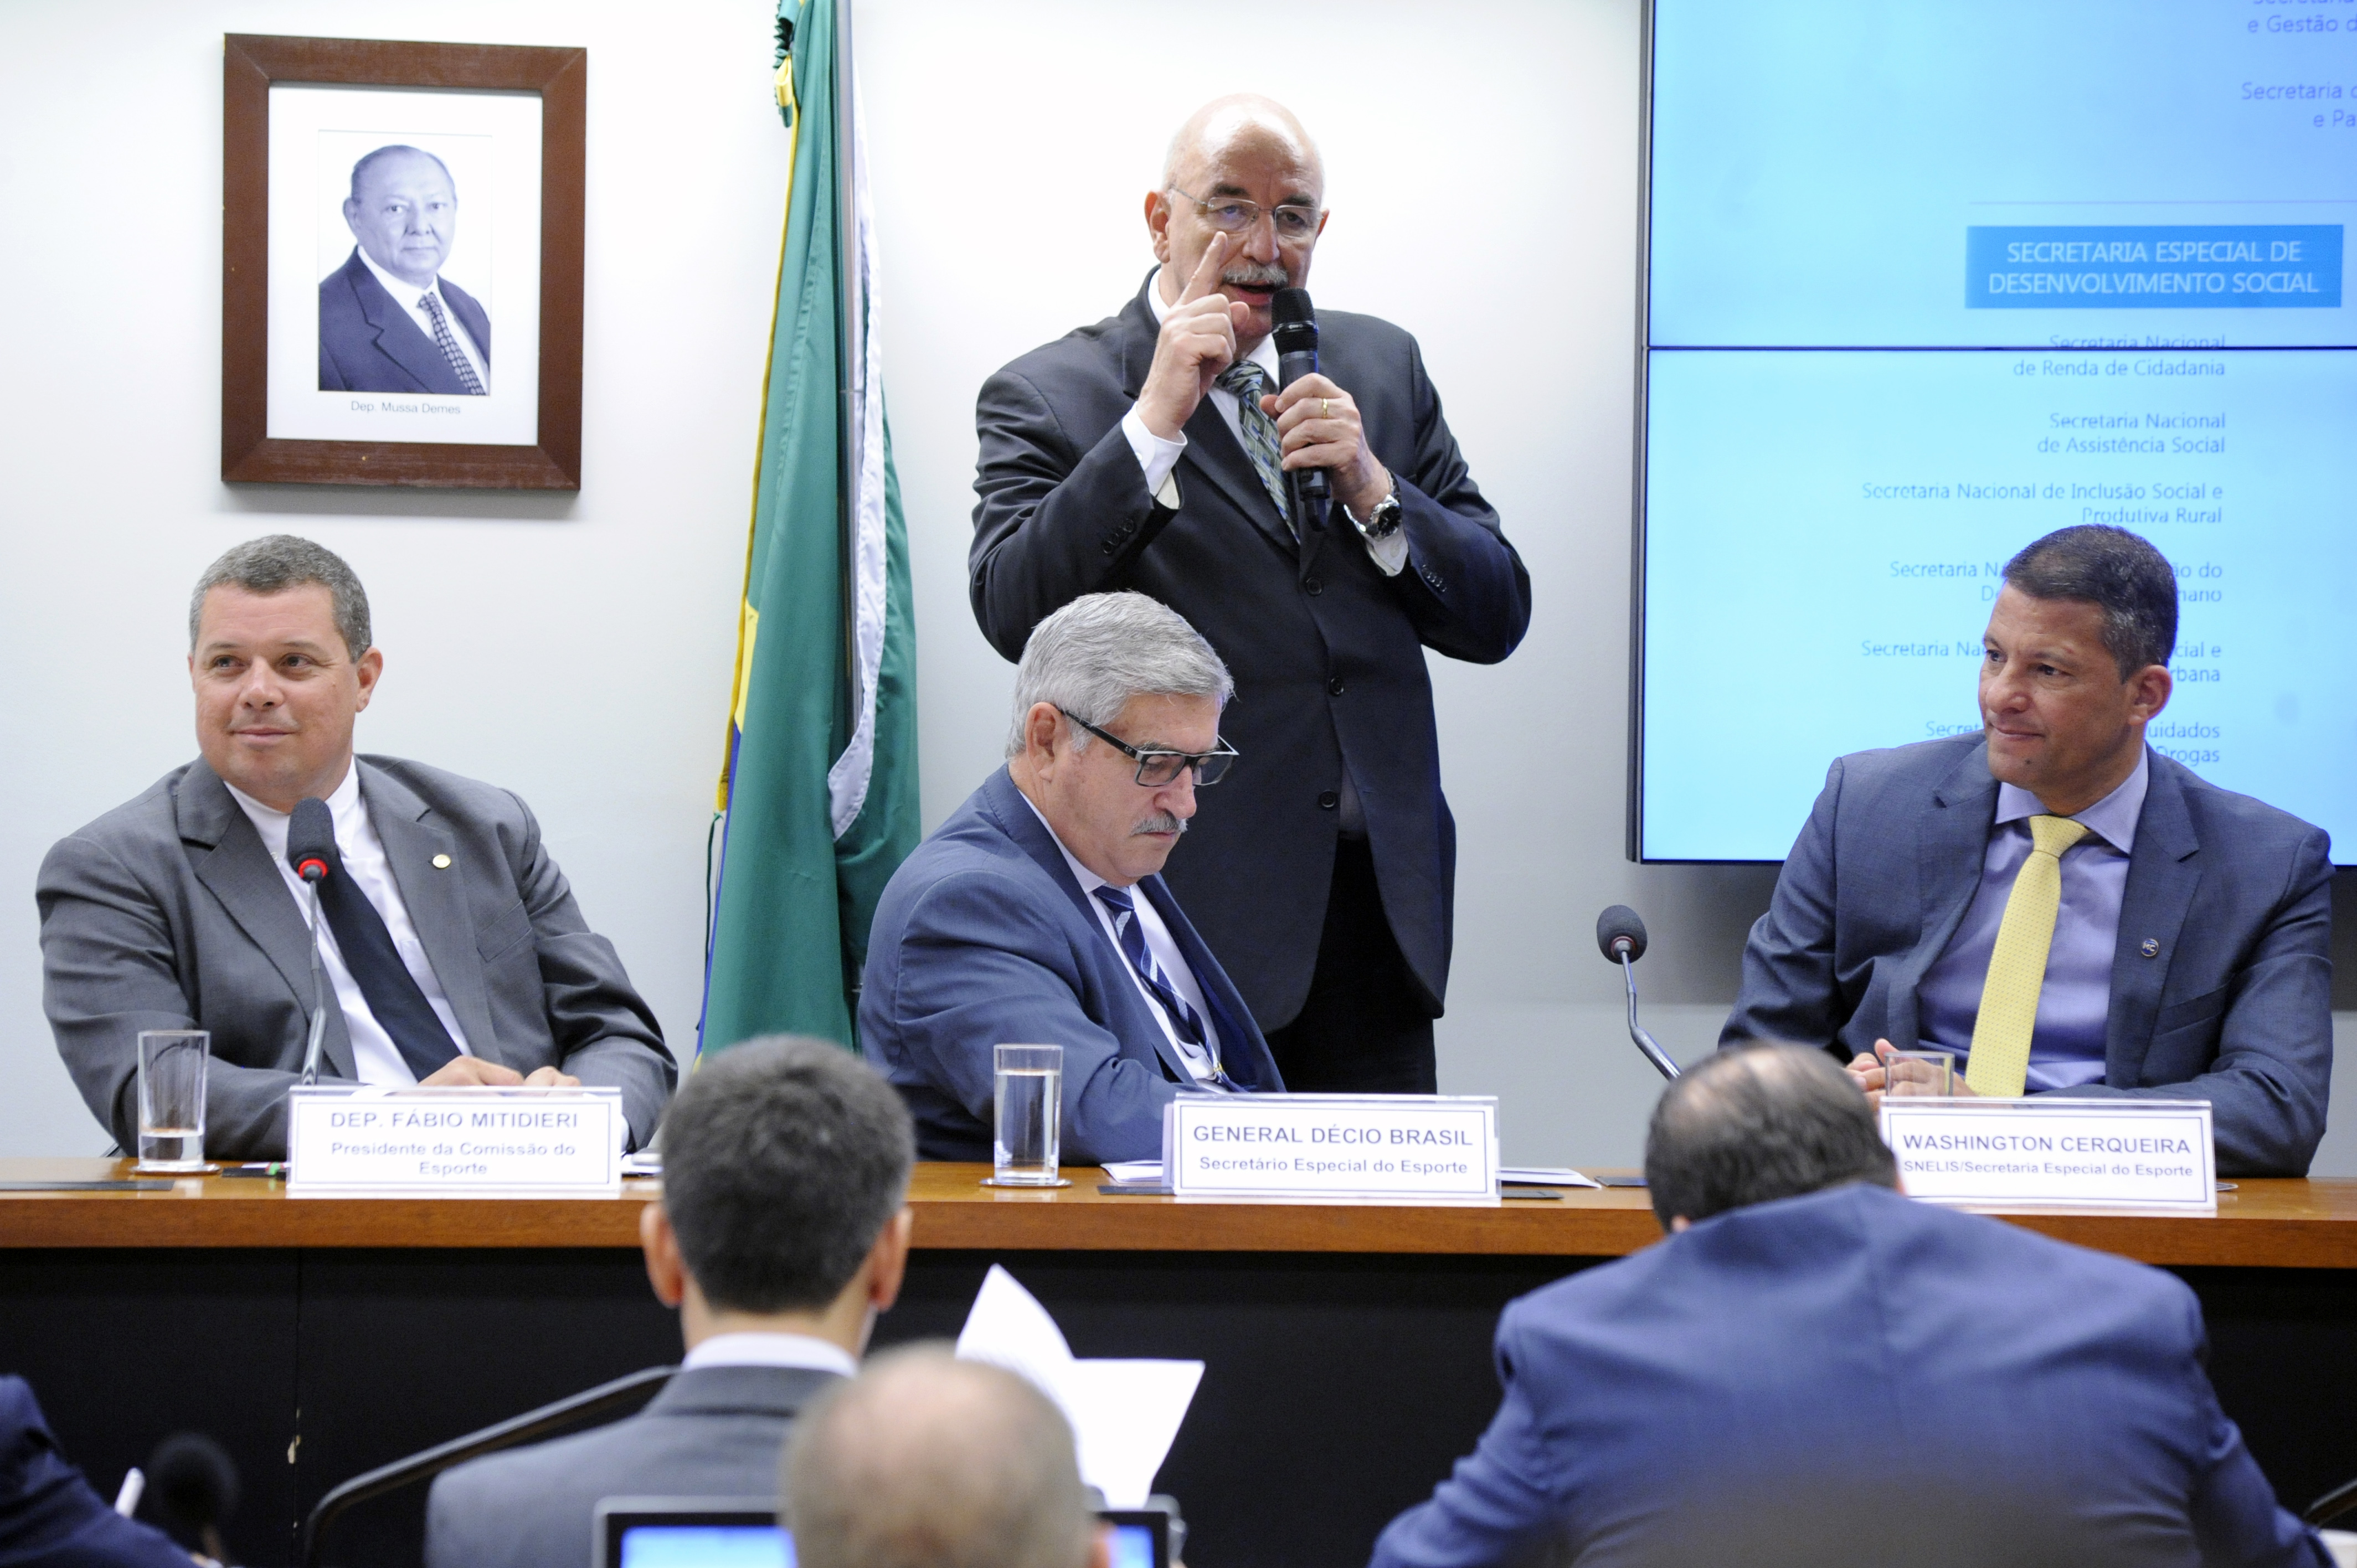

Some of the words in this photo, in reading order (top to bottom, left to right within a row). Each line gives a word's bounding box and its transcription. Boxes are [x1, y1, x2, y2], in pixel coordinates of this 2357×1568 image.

[2248, 20, 2258, 33] e
[2267, 14, 2338, 32] Gestão
[2242, 82, 2342, 100] Secretaria
[2313, 115, 2324, 127] e
[2007, 241, 2147, 262] SECRETARIA
[2155, 240, 2261, 262] ESPECIAL
[2270, 240, 2302, 261] DE
[1989, 273, 2225, 294] DESENVOLVIMENTO
[2232, 272, 2318, 293] SOCIAL
[2014, 360, 2036, 375] de
[2044, 360, 2098, 375] Renda
[2106, 360, 2128, 375] de
[2134, 359, 2225, 375] Cidadania
[382, 401, 418, 413] Mussa
[422, 403, 460, 414] Demes
[2051, 414, 2138, 428] Secretaria
[2146, 414, 2225, 429] Nacional
[2037, 437, 2060, 452] de
[2066, 436, 2165, 453] Assistência
[2172, 436, 2224, 453] Social
[1863, 484, 1949, 498] Secretaria
[1958, 483, 2035, 499] Nacional
[2042, 483, 2065, 499] de
[2072, 483, 2145, 499] Inclusão
[2153, 483, 2205, 499] Social
[2212, 487, 2223, 499] e
[2082, 507, 2168, 523] Produtiva
[2176, 508, 2221, 523] Rural
[1891, 561, 1977, 577] Secretaria
[2199, 563, 2222, 578] do
[1862, 640, 1949, 657] Secretaria
[2174, 641, 2204, 657] cial
[2211, 646, 2221, 658] e
[2170, 666, 2220, 682] rbana
[2148, 721, 2220, 737] uidados
[331, 1112, 383, 1128] DEP.
[392, 1109, 463, 1127] FÁBIO
[472, 1113, 577, 1127] MITIDIERI
[1193, 1126, 1301, 1142] GENERAL
[1311, 1124, 1382, 1145] DÉCIO
[1391, 1129, 1471, 1145] BRASIL
[332, 1142, 425, 1154] Presidente
[433, 1143, 452, 1154] da
[460, 1142, 547, 1155] Comissão
[554, 1144, 575, 1155] do
[1903, 1135, 2052, 1151] WASHINGTON
[2061, 1137, 2190, 1153] CERQUEIRA
[420, 1162, 487, 1177] Esporte
[1200, 1157, 1288, 1170] Secretário
[1294, 1158, 1366, 1173] Especial
[1373, 1160, 1394, 1172] do
[1401, 1160, 1467, 1175] Esporte
[1904, 1161, 2039, 1173] SNELIS/Secretaria
[2044, 1163, 2106, 1175] Especial
[2112, 1164, 2130, 1175] do
[2135, 1164, 2193, 1177] Esporte
